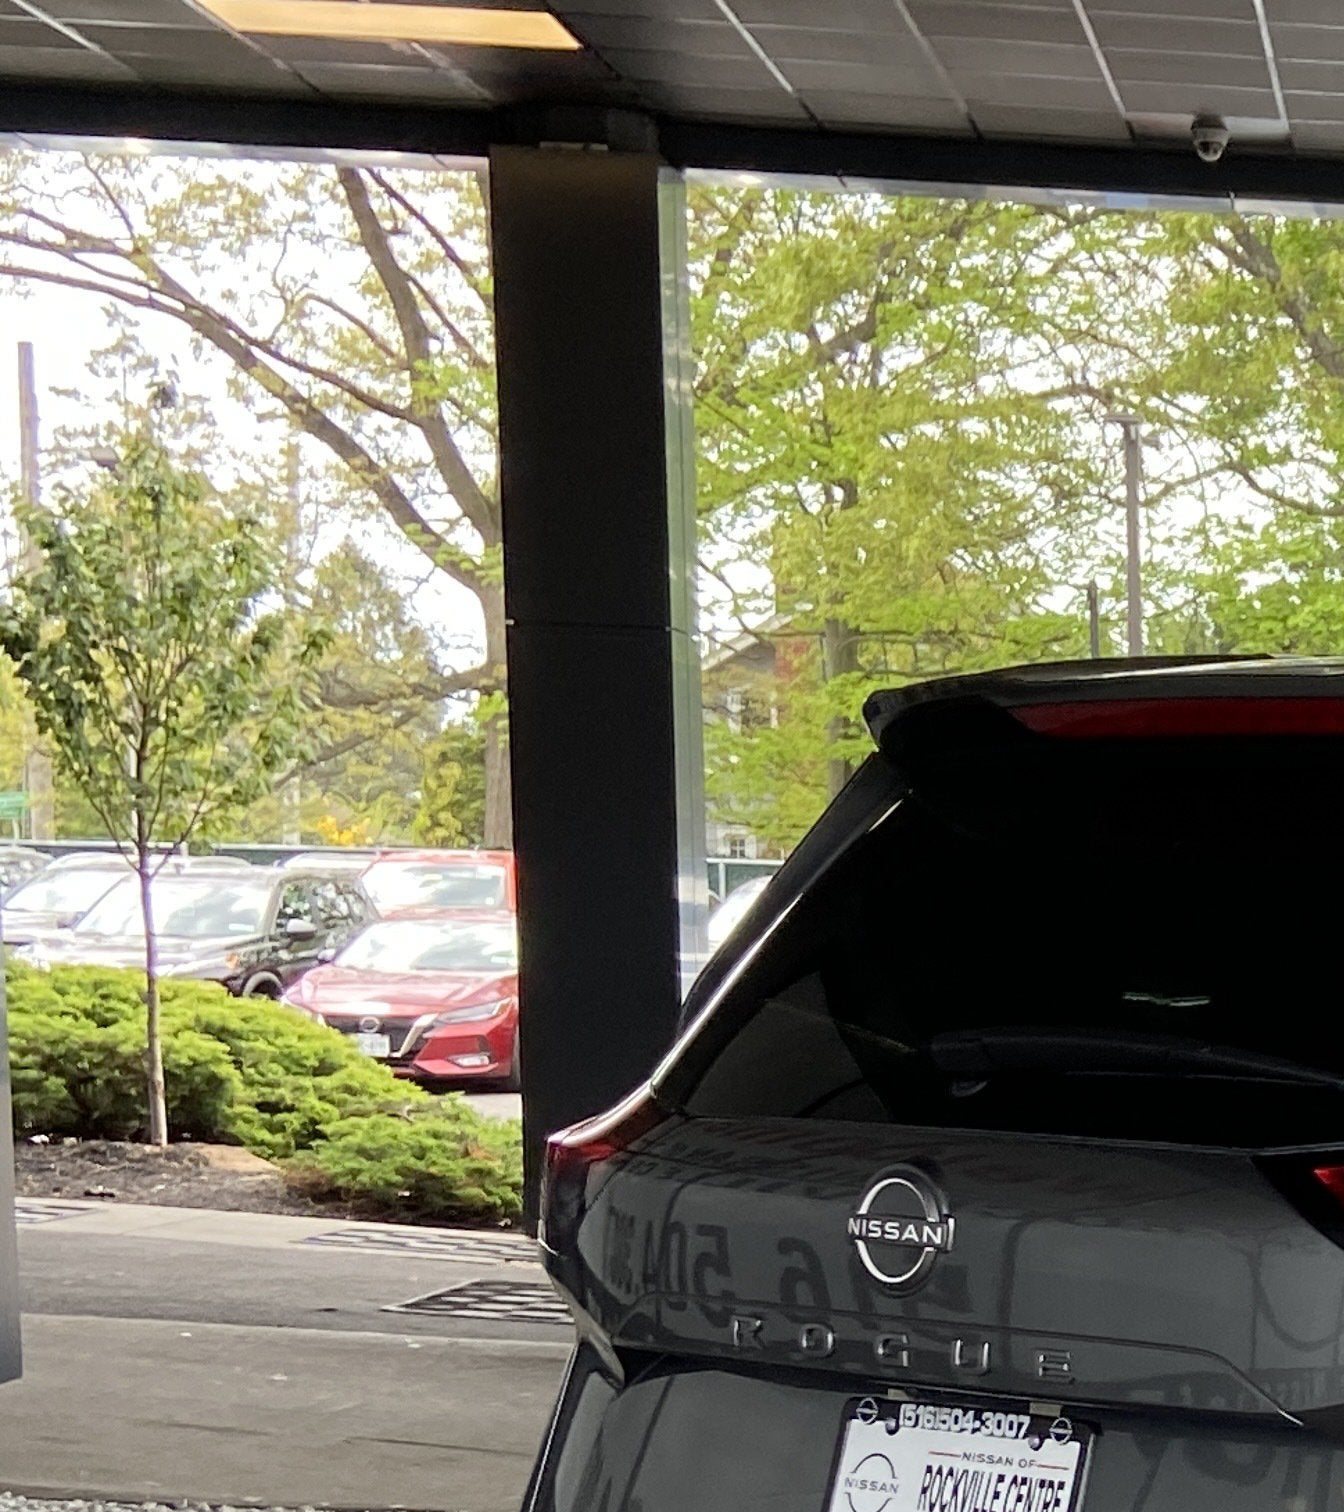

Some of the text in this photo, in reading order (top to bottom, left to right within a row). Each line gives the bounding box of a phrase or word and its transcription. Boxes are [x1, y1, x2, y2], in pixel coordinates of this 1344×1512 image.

[847, 1216, 943, 1245] NISSAN
[732, 1314, 1076, 1384] ROGUE
[961, 1452, 1036, 1469] NISSAN OF
[844, 1477, 900, 1494] NISSAN
